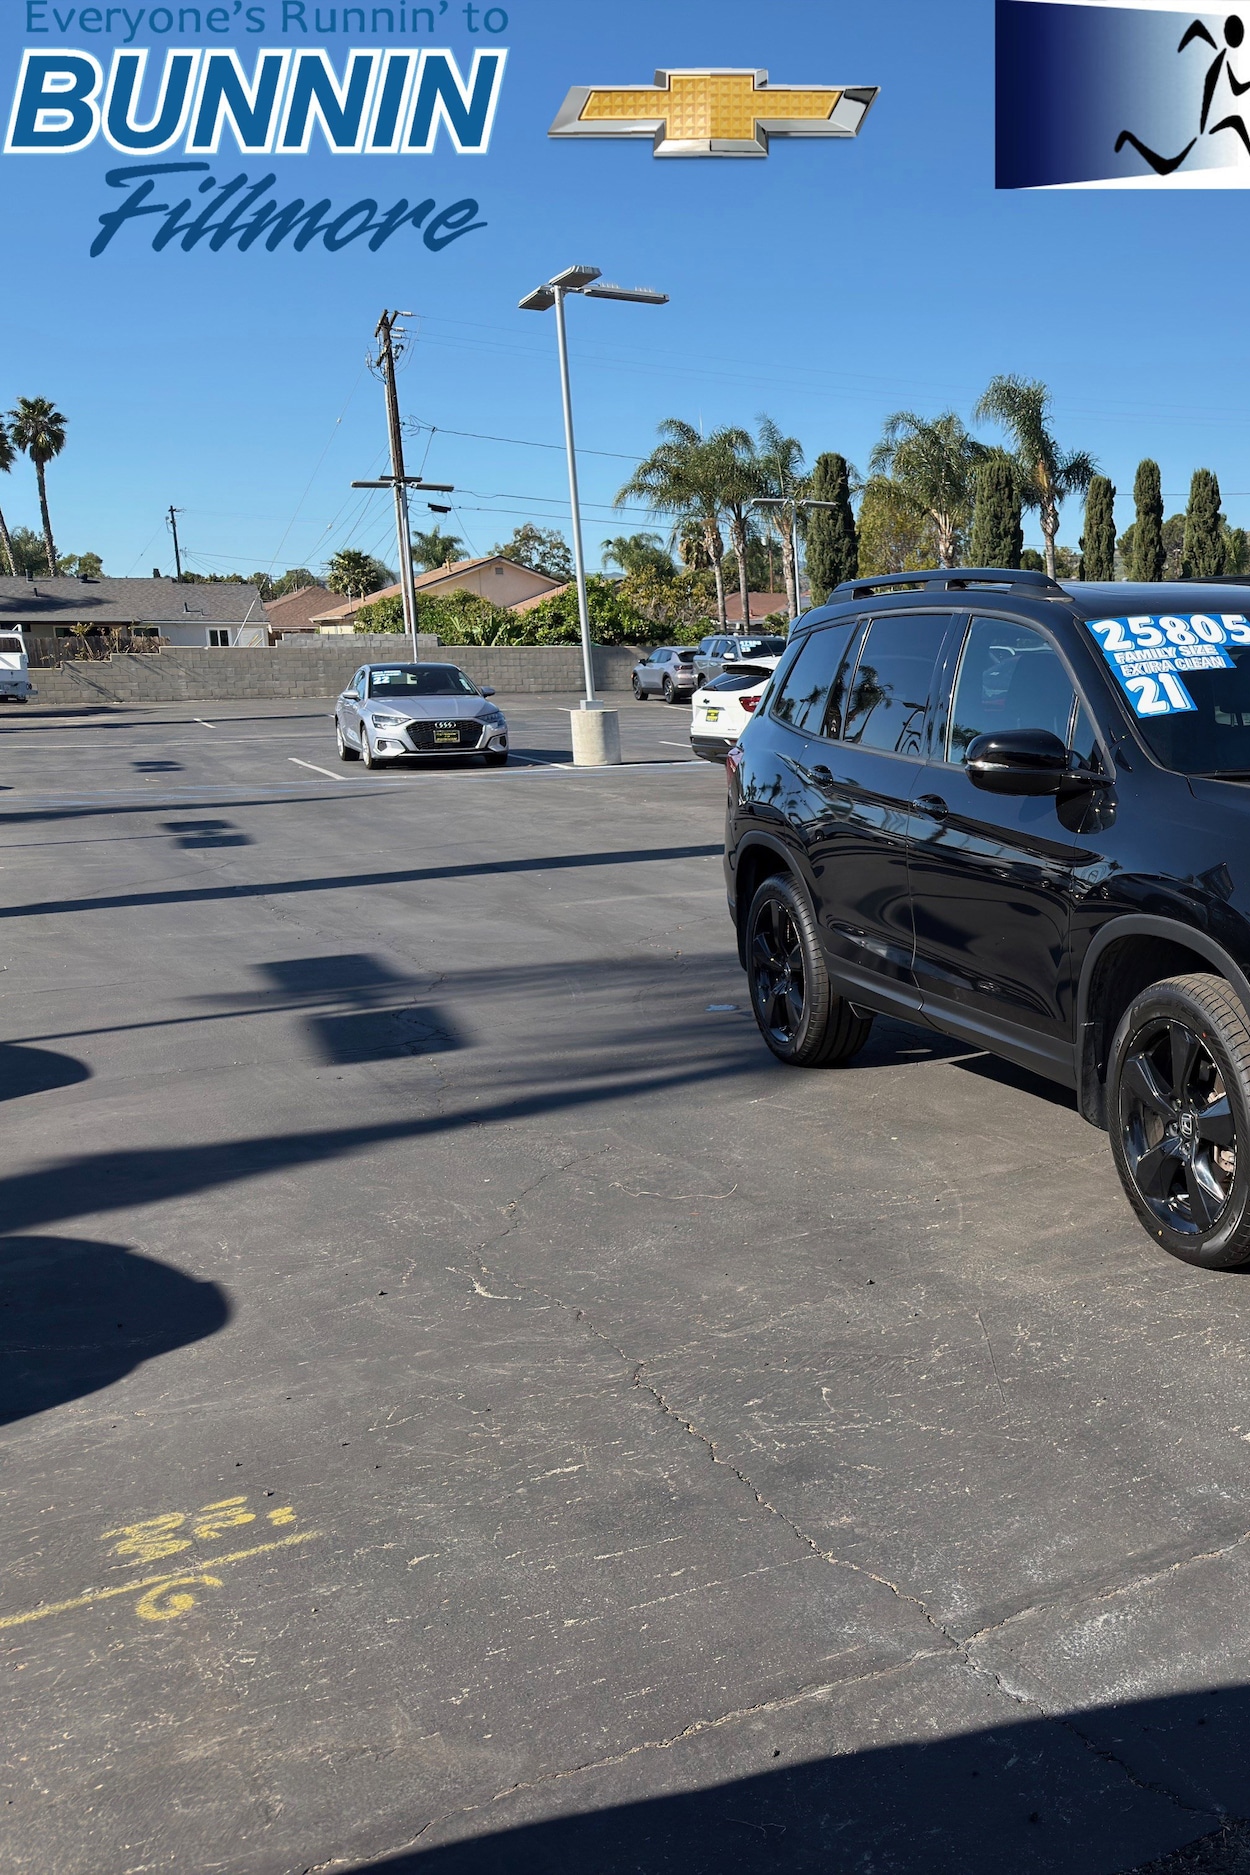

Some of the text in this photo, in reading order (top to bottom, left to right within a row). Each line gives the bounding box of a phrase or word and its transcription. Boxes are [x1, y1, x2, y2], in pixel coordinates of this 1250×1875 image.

[1113, 644, 1220, 665] FAMILY SIZE
[1120, 655, 1227, 678] EXTRA CLEAN
[1125, 672, 1191, 714] 21
